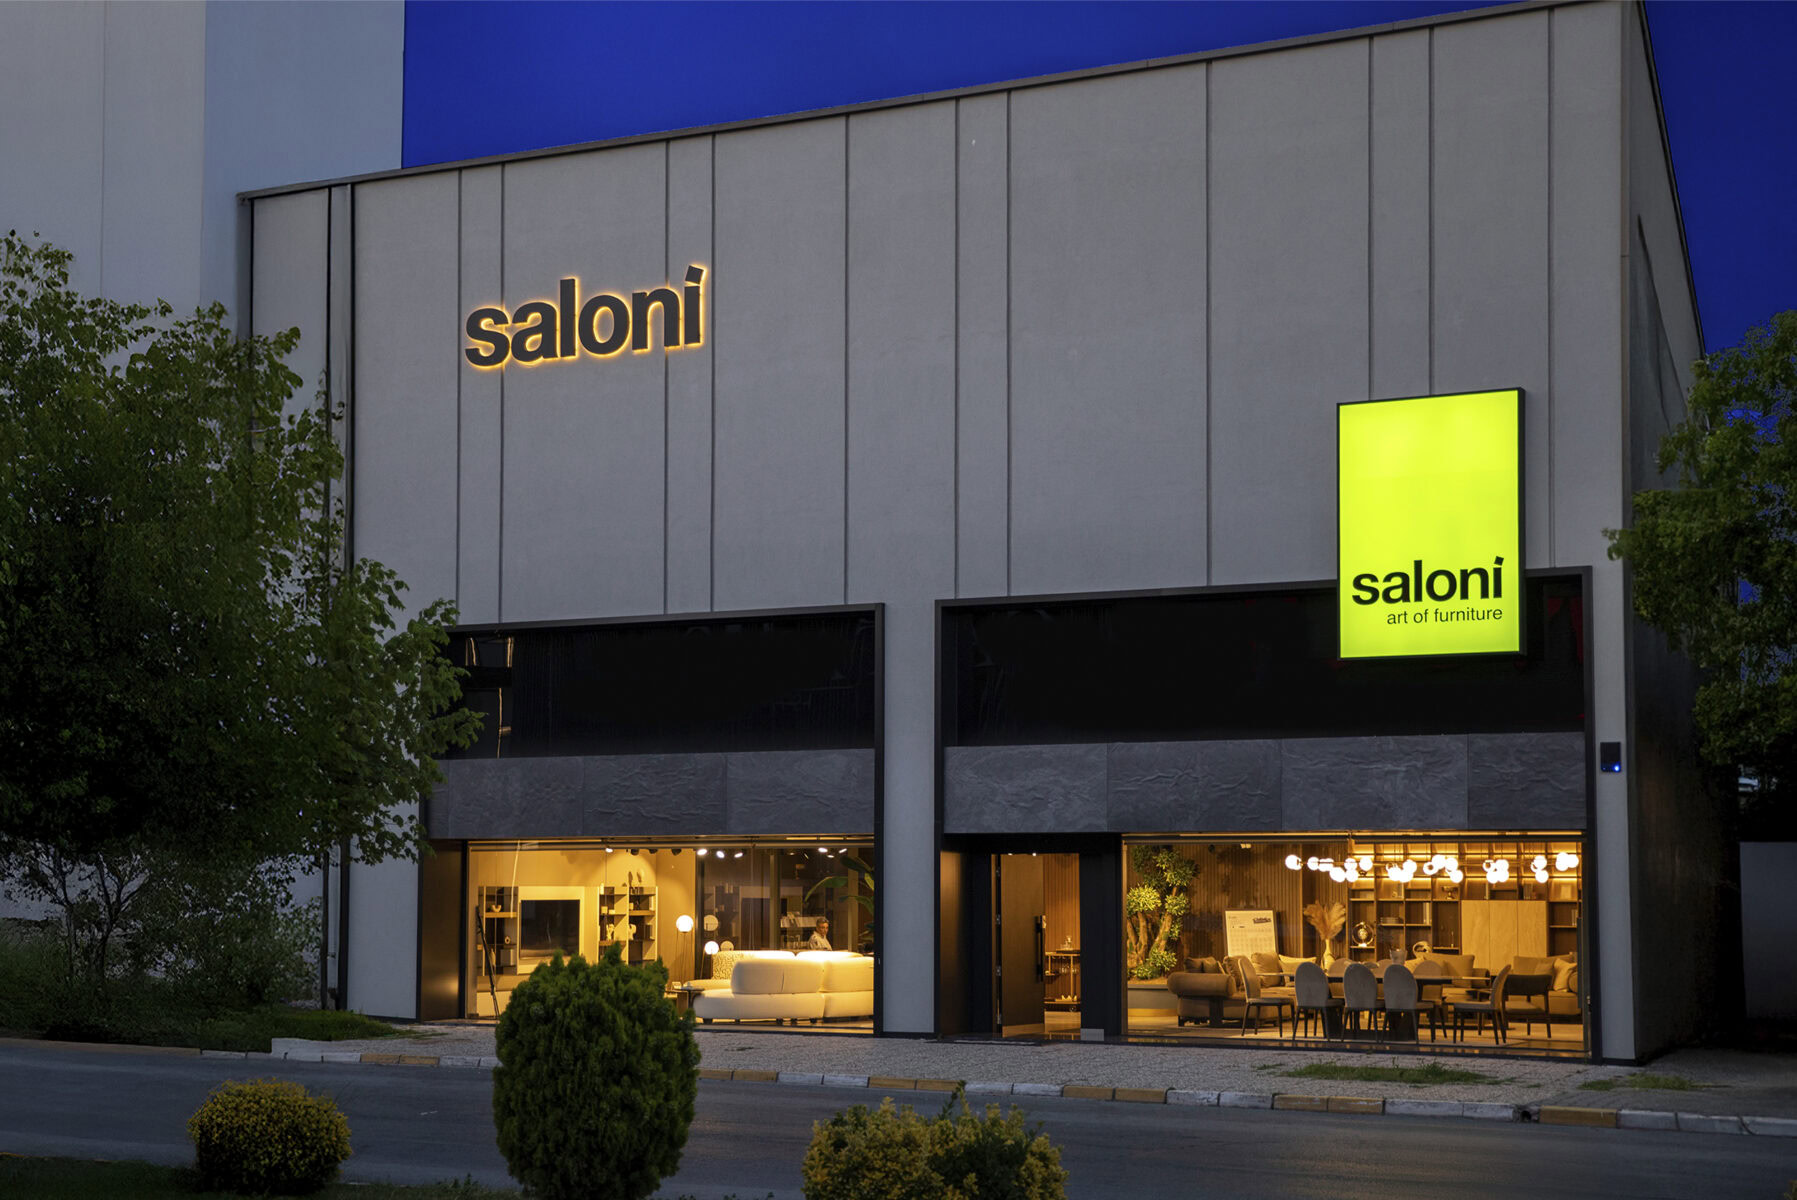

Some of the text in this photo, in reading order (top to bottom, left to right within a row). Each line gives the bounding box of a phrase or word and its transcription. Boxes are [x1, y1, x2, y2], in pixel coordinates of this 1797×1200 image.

[465, 265, 704, 368] saloni
[1352, 556, 1504, 605] saloni
[1387, 607, 1503, 625] art of furniture
